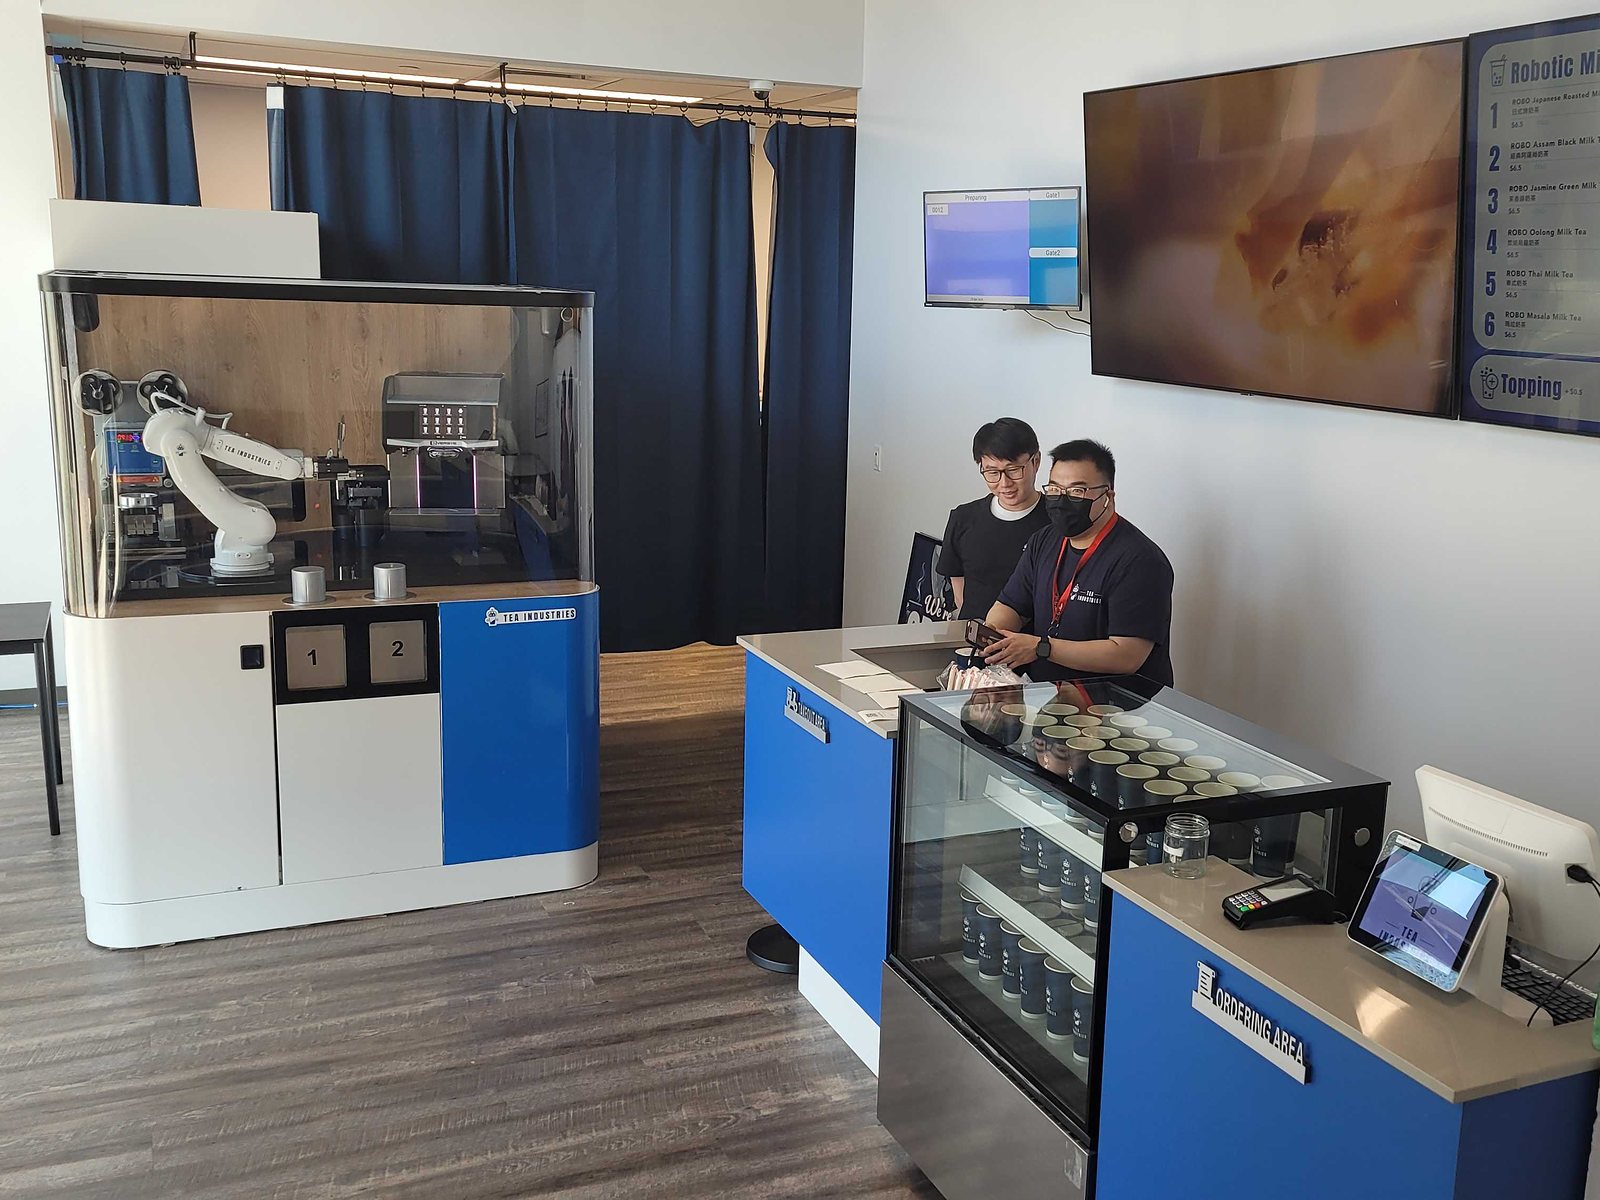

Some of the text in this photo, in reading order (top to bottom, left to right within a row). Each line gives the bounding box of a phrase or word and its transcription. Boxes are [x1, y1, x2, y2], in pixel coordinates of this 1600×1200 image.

[1511, 54, 1574, 84] Robotic
[1512, 97, 1531, 105] ROBO
[1532, 95, 1561, 104] Japanese
[1563, 91, 1590, 100] Roasted
[1490, 102, 1498, 129] 1
[1510, 141, 1531, 149] ROBO
[1557, 138, 1577, 147] Black
[1579, 135, 1595, 144] Milk
[1489, 145, 1500, 172] 2
[1509, 164, 1522, 172] $6.5
[1045, 191, 1060, 199] Gate1
[1509, 181, 1598, 192] ROBO Jasmine Green Milk
[965, 194, 987, 202] Preparing
[1488, 187, 1499, 214] 3
[1530, 228, 1555, 238] Oolong
[1557, 228, 1573, 236] Milk
[1575, 228, 1587, 236] Tea
[1487, 229, 1497, 255] 4
[1045, 249, 1061, 257] Gate2
[1506, 270, 1526, 278] ROBO
[1528, 270, 1543, 278] Thai
[1544, 270, 1560, 278] Milk
[1486, 271, 1496, 297] 5
[1505, 291, 1519, 299] $6.5
[1485, 311, 1495, 337] 6
[1505, 311, 1582, 322] ROBO Masala Milk Tea
[1501, 373, 1562, 401] Topping
[224, 445, 271, 466] TEA INDUSTRIES
[503, 609, 575, 622] TEA INDUSTRIES
[924, 594, 952, 622] We're
[307, 648, 317, 666] 1
[391, 640, 404, 657] 2
[1401, 926, 1418, 943] TEA
[1216, 988, 1305, 1066] ORDERING AREA
